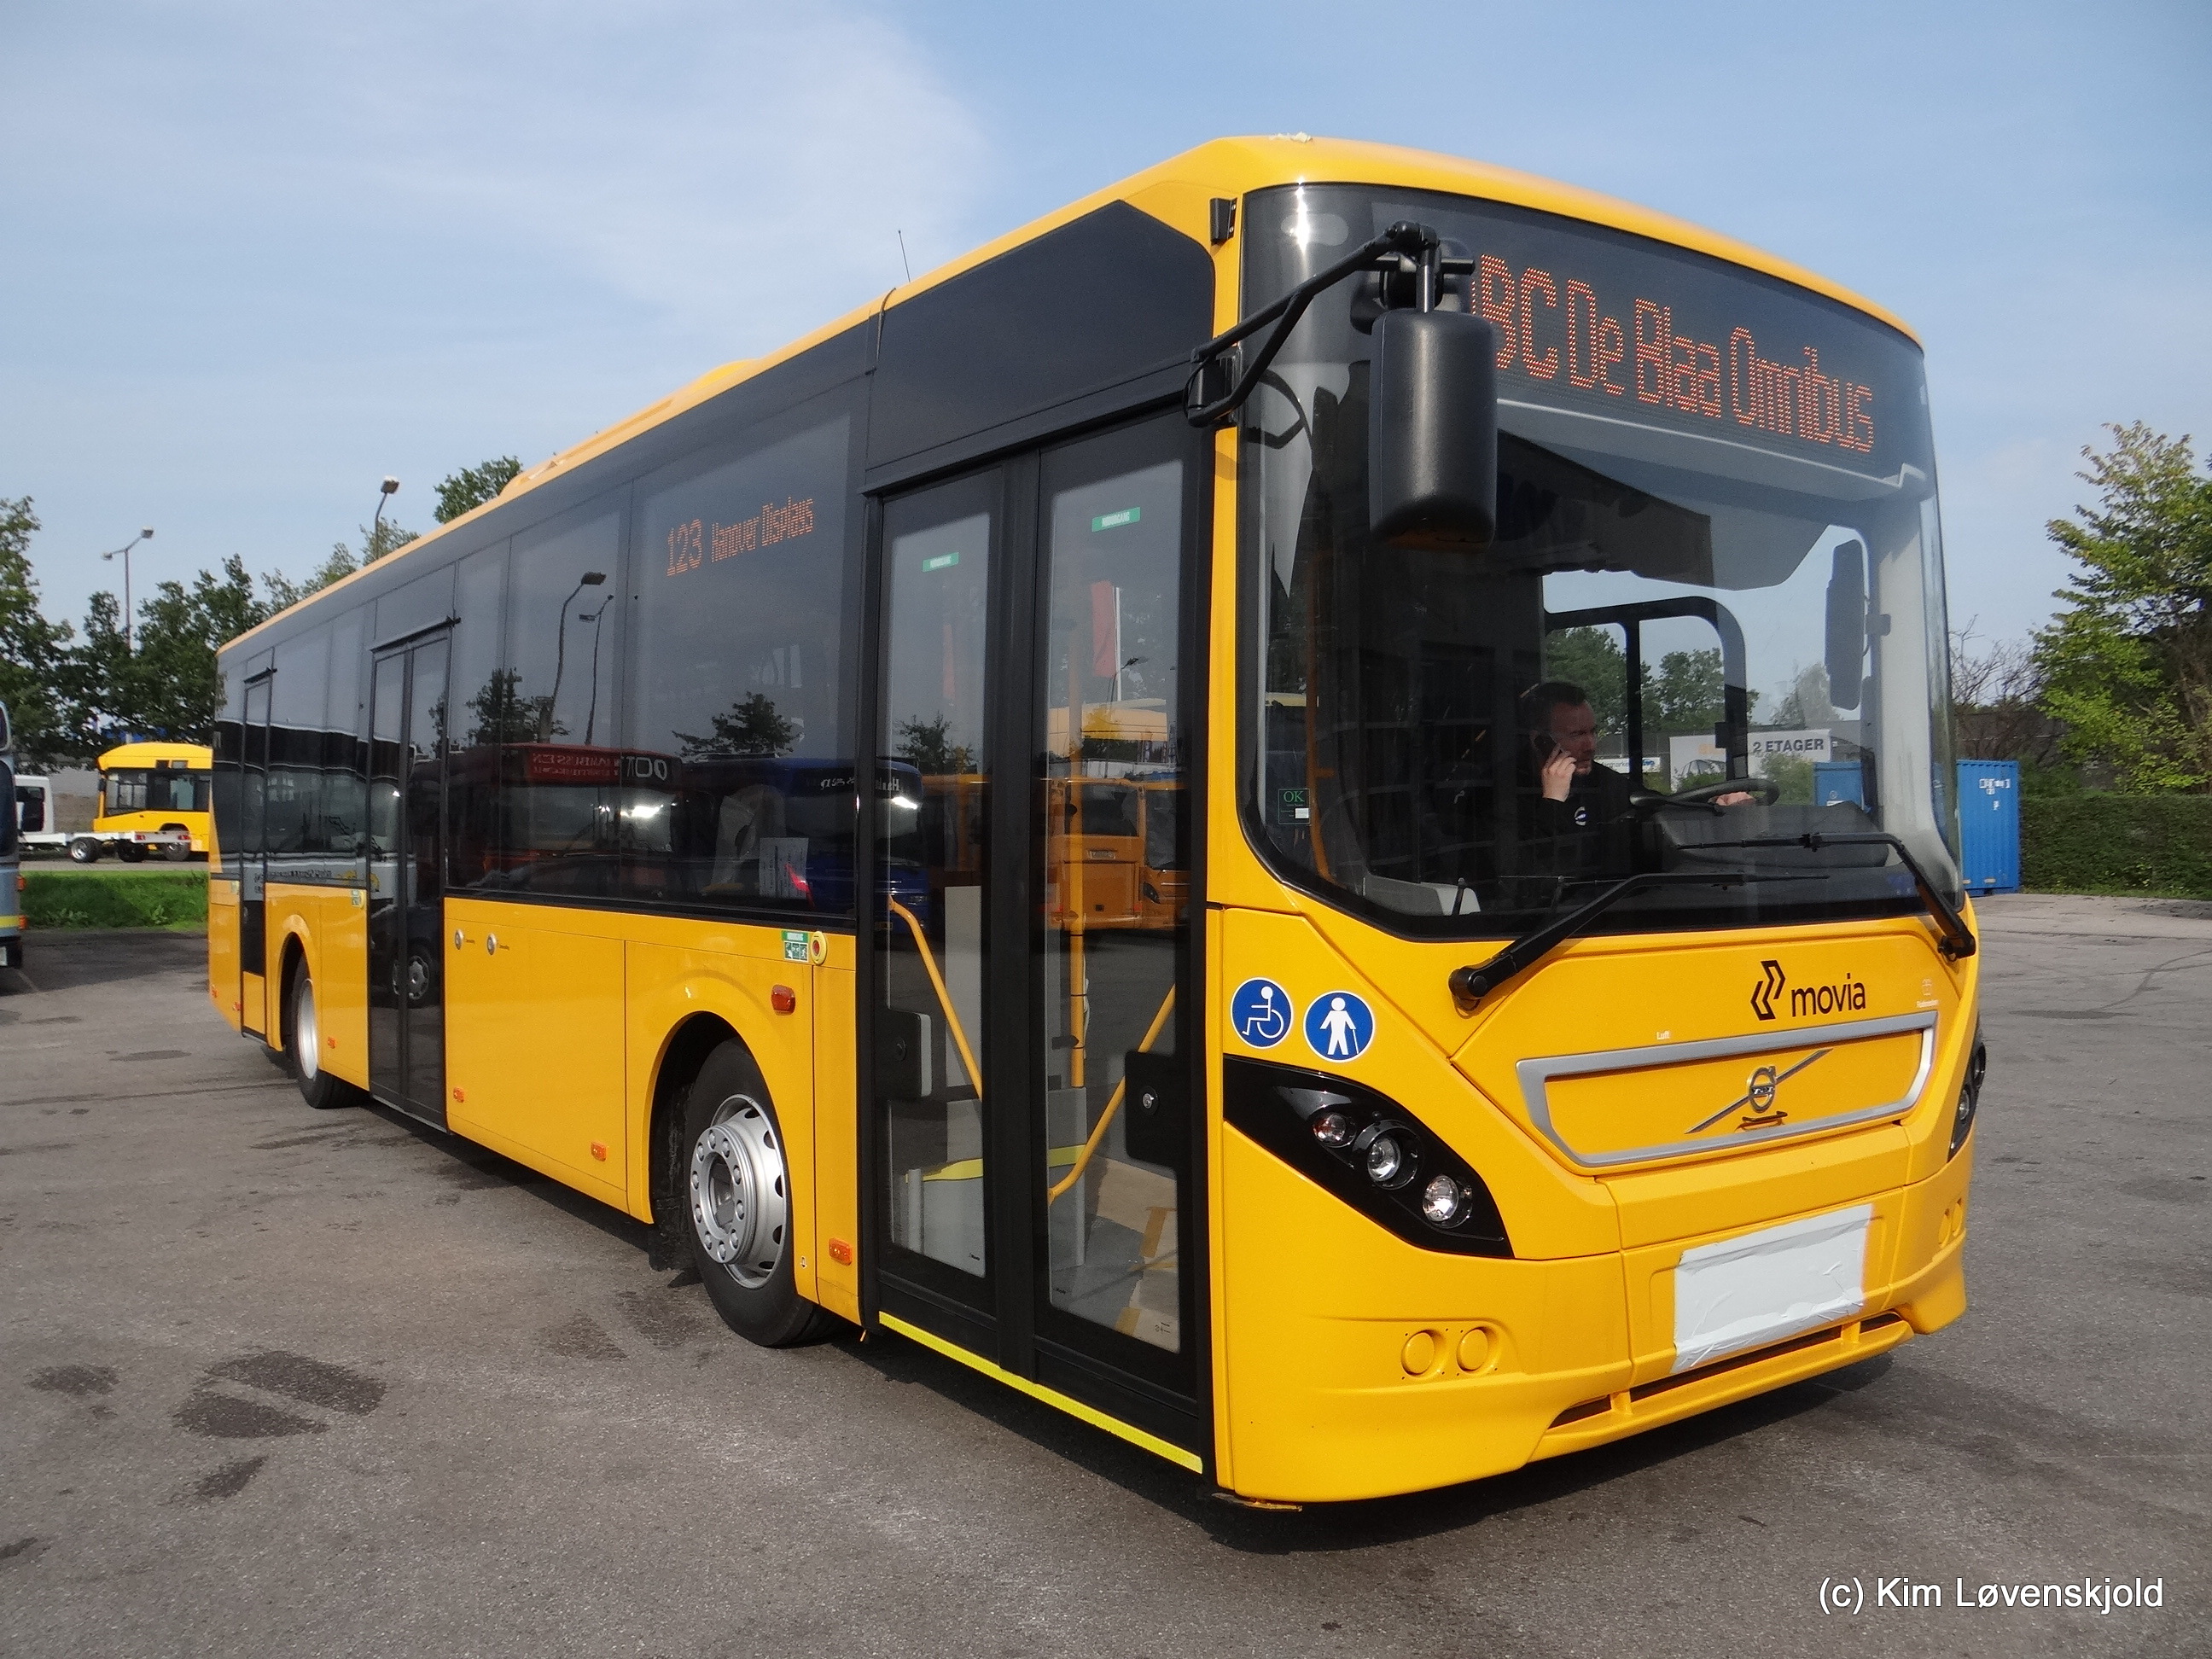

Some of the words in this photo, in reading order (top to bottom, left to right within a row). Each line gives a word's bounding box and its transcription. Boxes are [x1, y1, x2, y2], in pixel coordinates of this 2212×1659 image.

[1471, 253, 1557, 379] BC
[1567, 278, 1625, 396] De
[1634, 297, 1722, 419] Blaa
[1729, 326, 1876, 454] Omnibus
[667, 519, 703, 577] 123
[1752, 741, 1763, 754] 2
[1765, 738, 1824, 753] ETAGER
[1284, 790, 1305, 802] OK
[1791, 973, 1866, 1017] movia
